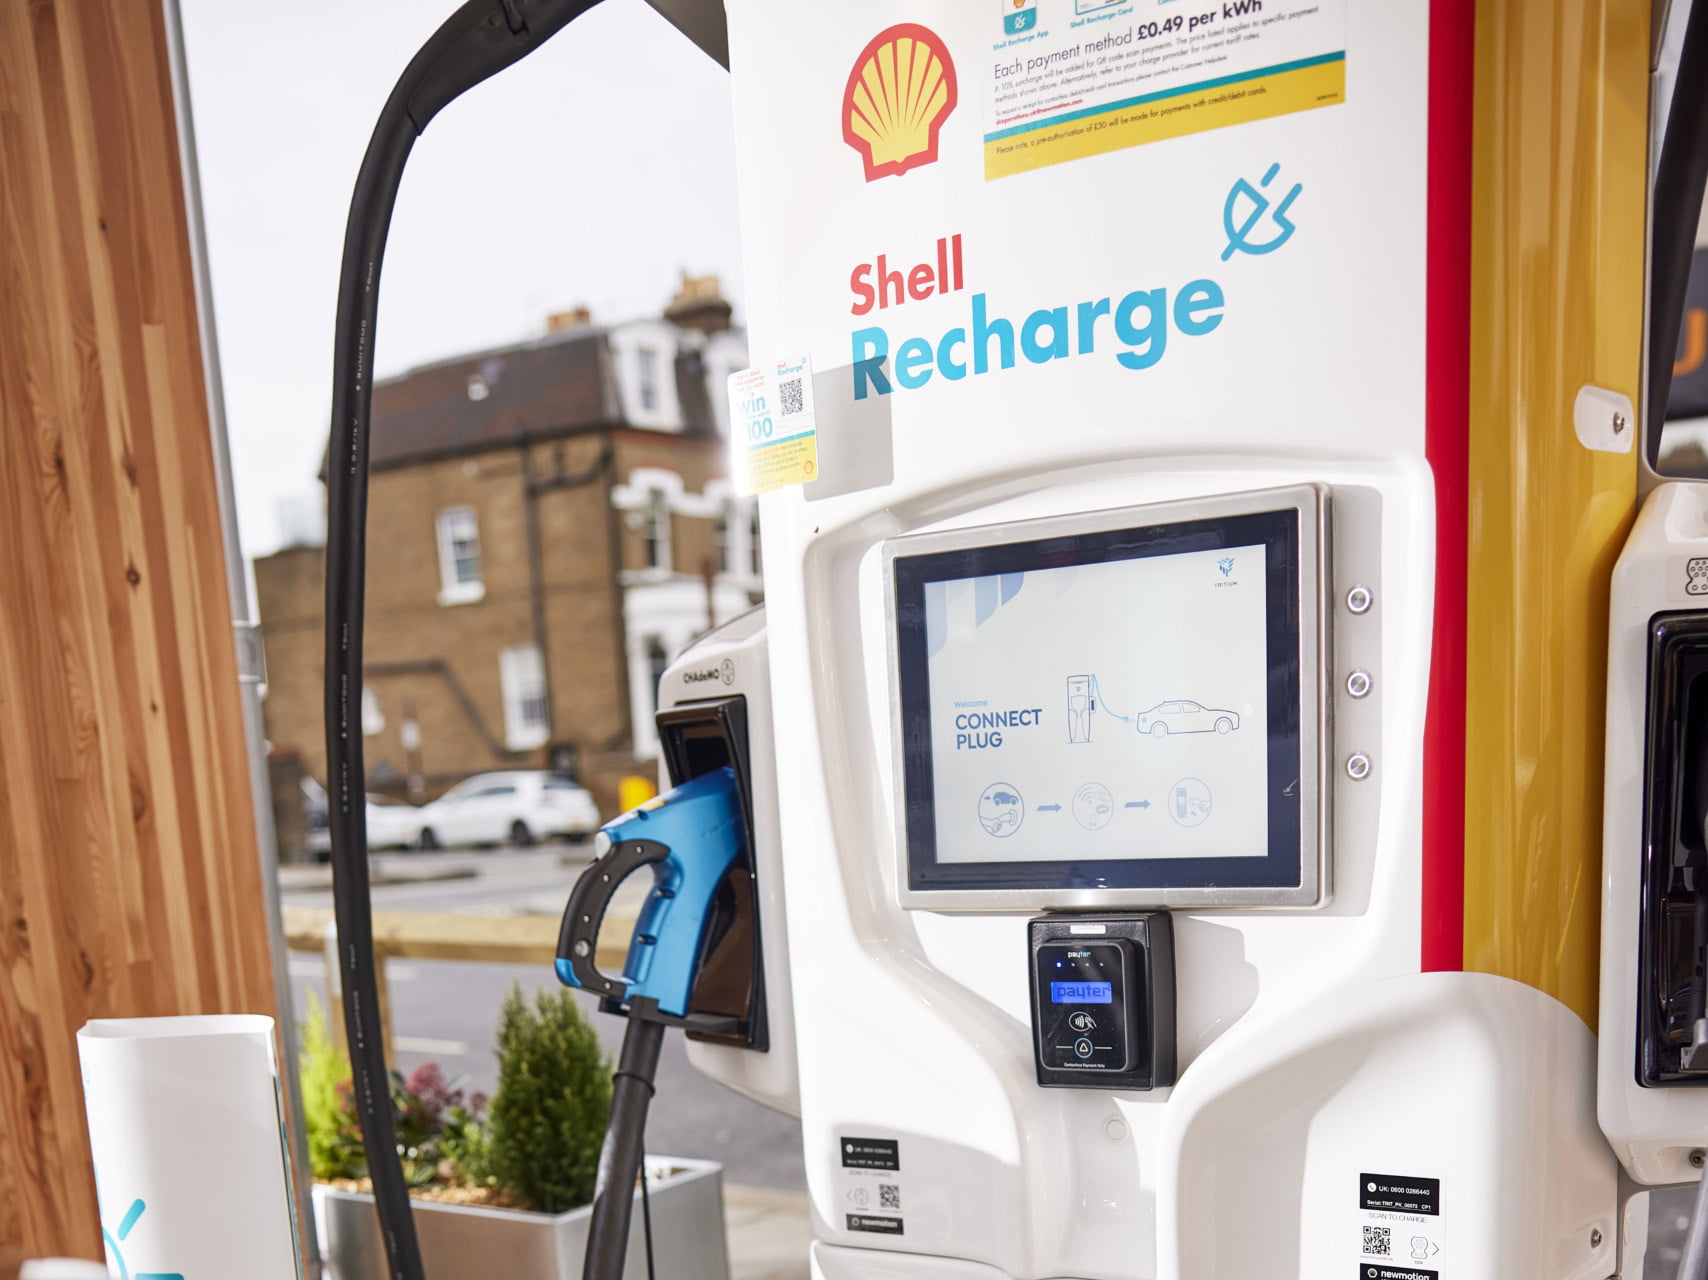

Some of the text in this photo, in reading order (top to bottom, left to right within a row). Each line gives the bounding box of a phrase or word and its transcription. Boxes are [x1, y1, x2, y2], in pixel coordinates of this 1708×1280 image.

[994, 0, 1262, 79] Each payment method £0.49 per kWh
[1015, 75, 1043, 87] surcharge
[996, 142, 1014, 155] Please
[1036, 127, 1085, 146] pre-authorisation
[850, 233, 964, 316] Shell
[851, 278, 1225, 401] Recharge
[954, 699, 988, 708] Welcome
[955, 709, 1042, 731] CONNECT
[956, 732, 1003, 750] PLUG
[1067, 951, 1092, 959] payter
[1057, 984, 1112, 1000] payter
[1368, 1212, 1387, 1220] SCAN
[1389, 1213, 1398, 1221] TO
